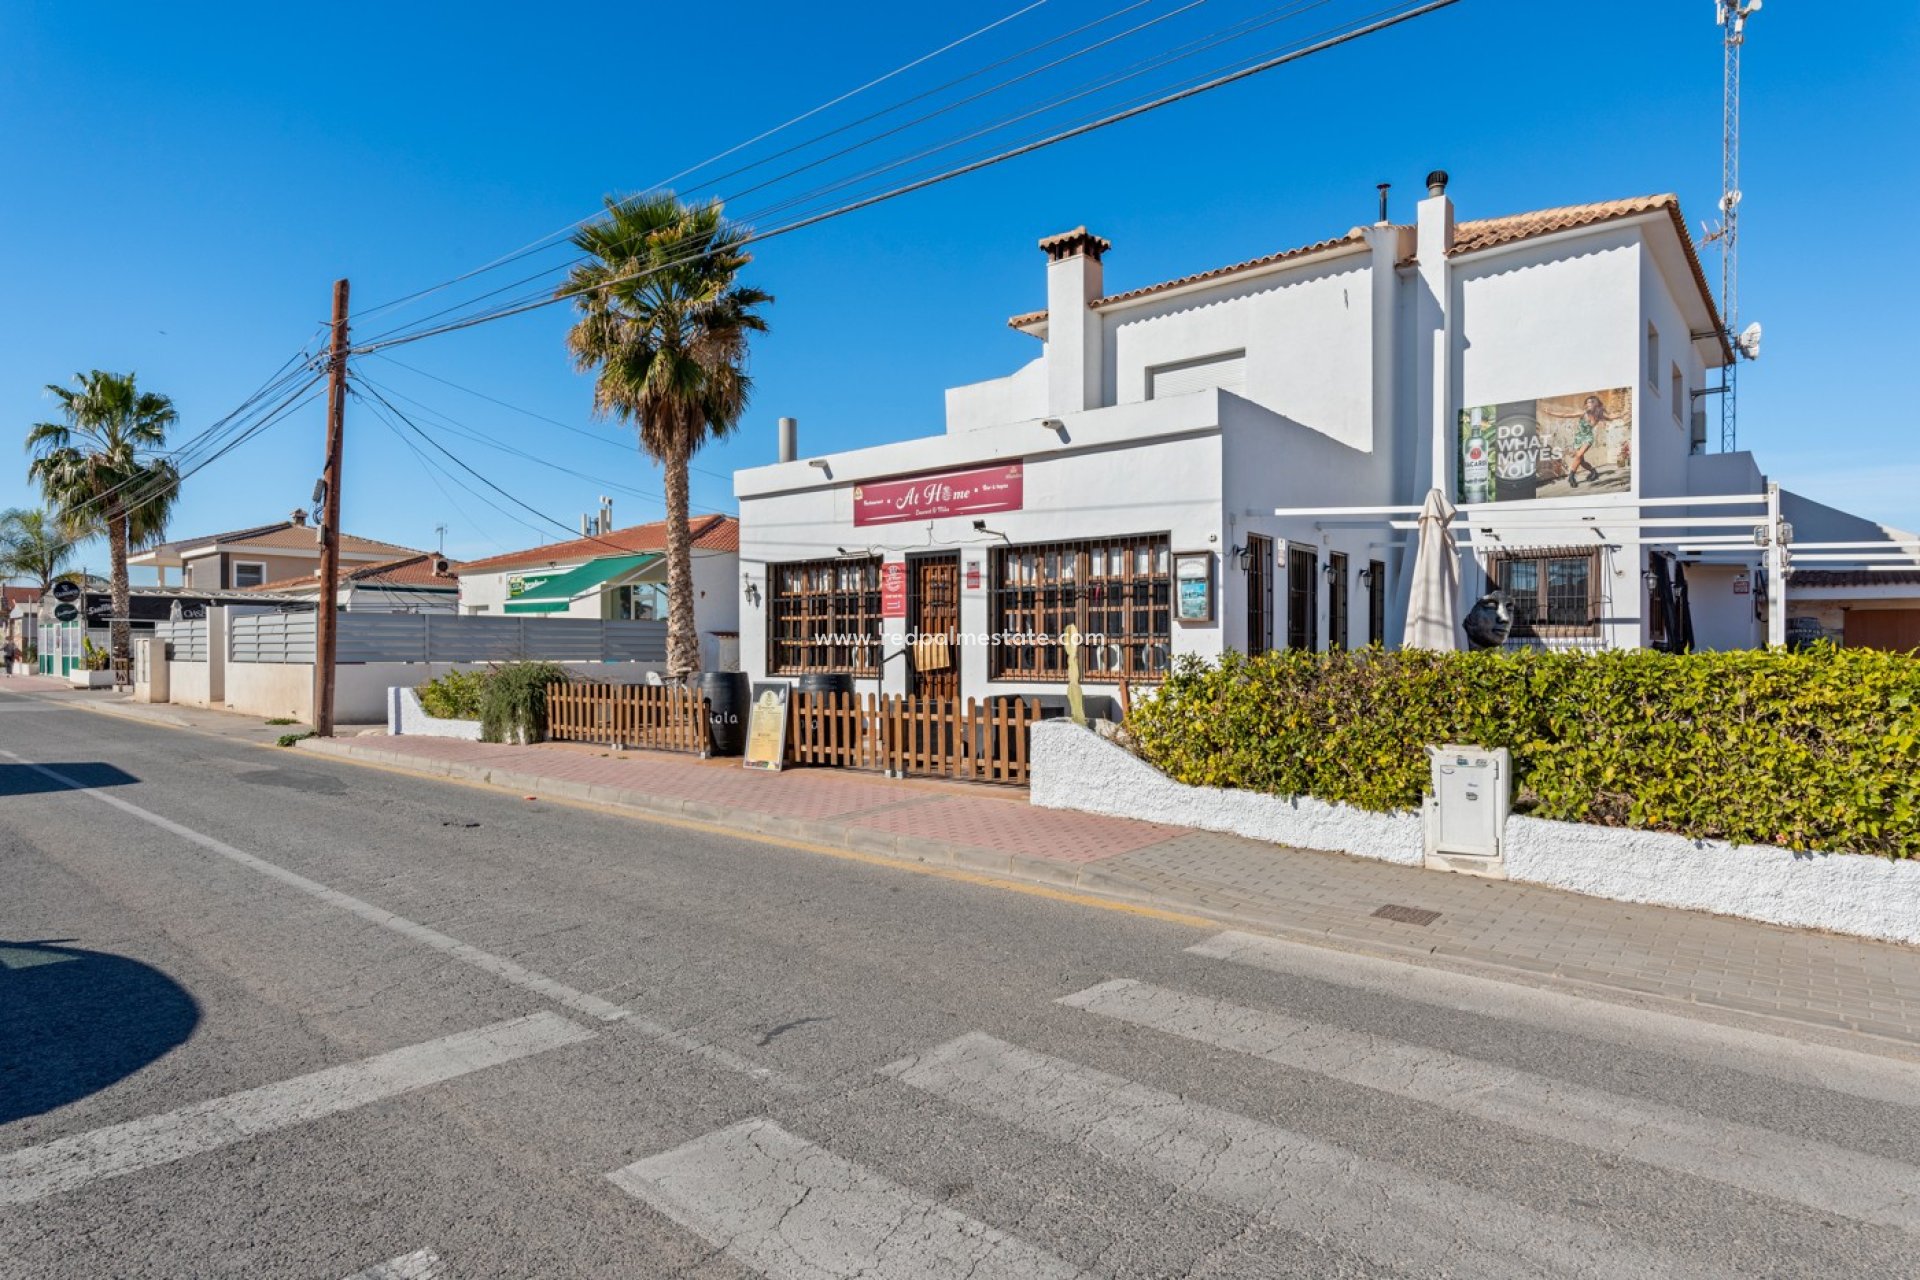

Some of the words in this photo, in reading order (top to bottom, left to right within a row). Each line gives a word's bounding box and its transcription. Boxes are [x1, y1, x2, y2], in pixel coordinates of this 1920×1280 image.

[1498, 424, 1524, 438] DO
[1497, 434, 1551, 451] WHAT
[1498, 447, 1562, 465] MOVES
[1498, 463, 1535, 478] YOU
[895, 486, 919, 509] At
